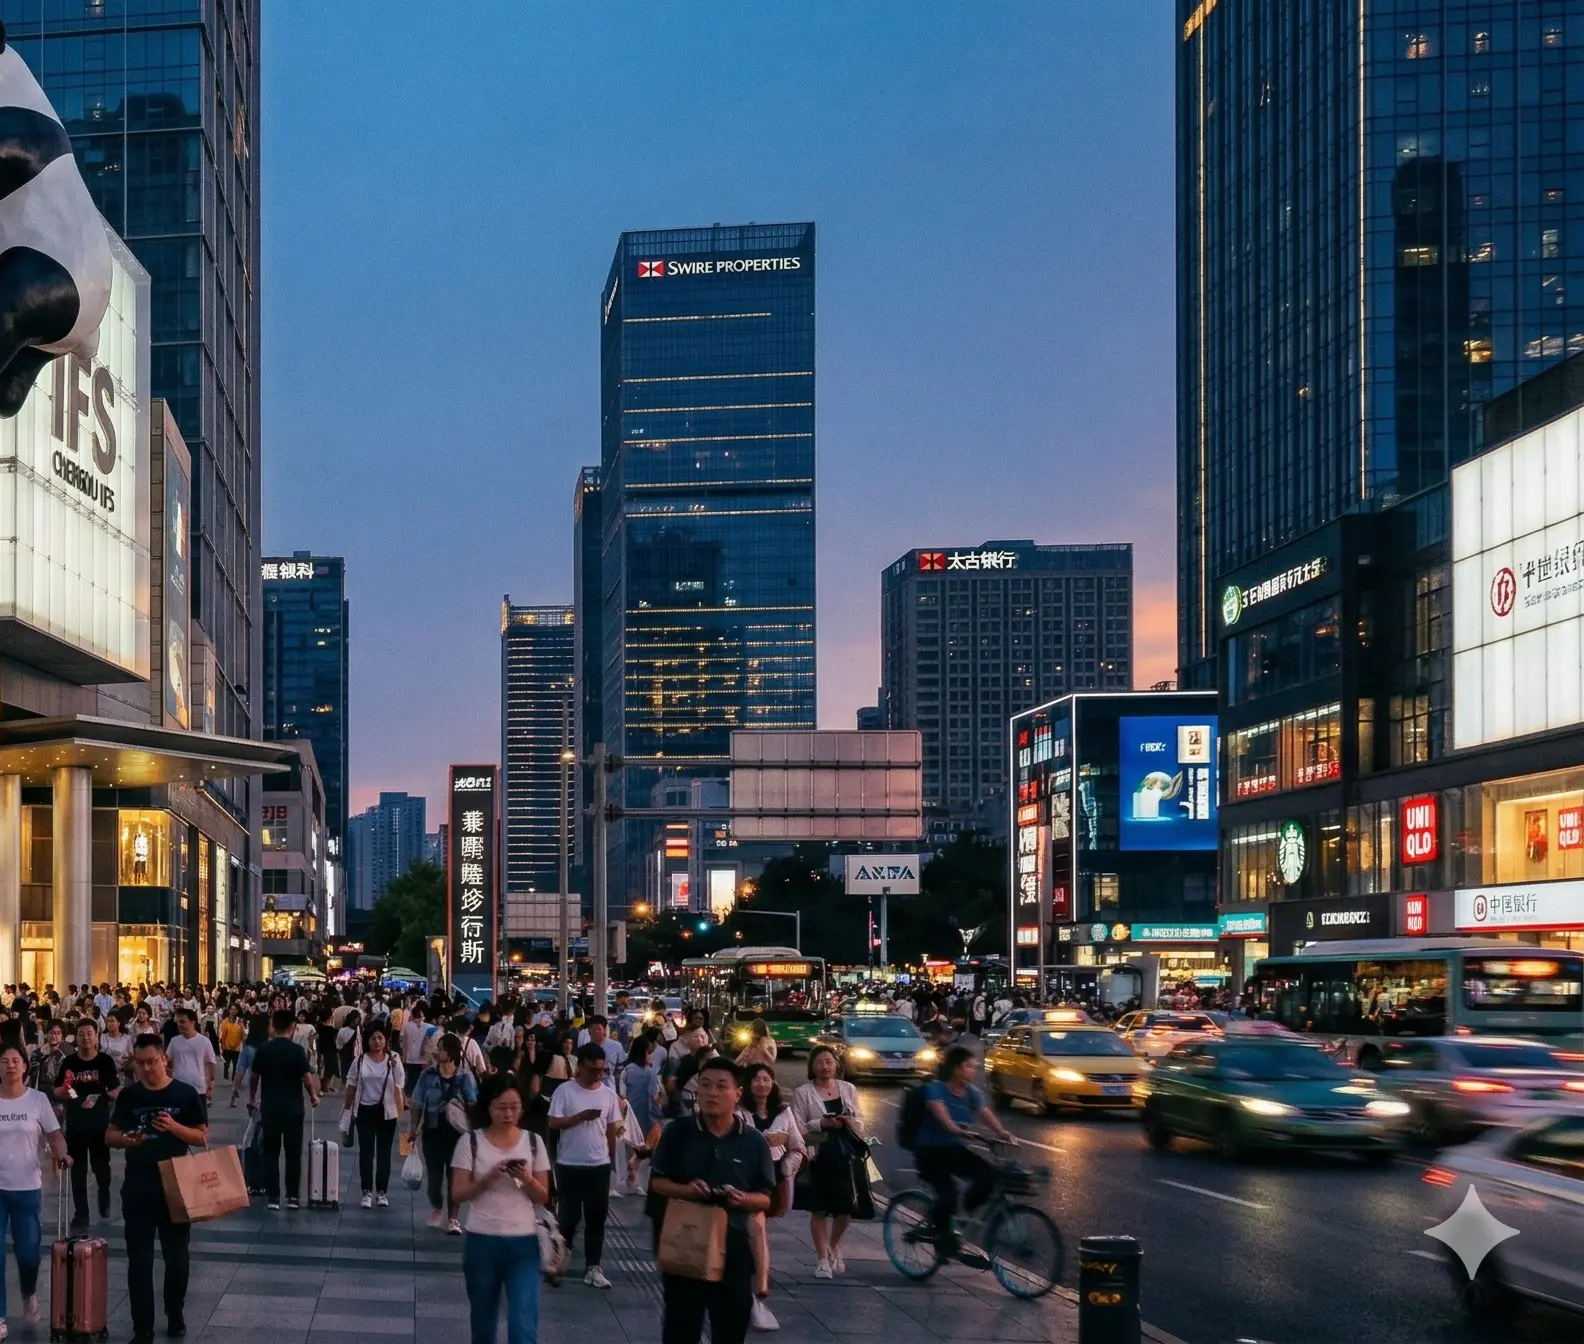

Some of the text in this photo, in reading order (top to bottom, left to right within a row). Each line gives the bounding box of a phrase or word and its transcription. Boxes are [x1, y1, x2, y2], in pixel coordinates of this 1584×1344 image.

[667, 256, 801, 276] SWIRE PROPERTIES
[51, 352, 117, 475] IFS
[1406, 805, 1430, 830] UNI
[1406, 831, 1432, 859] QLO
